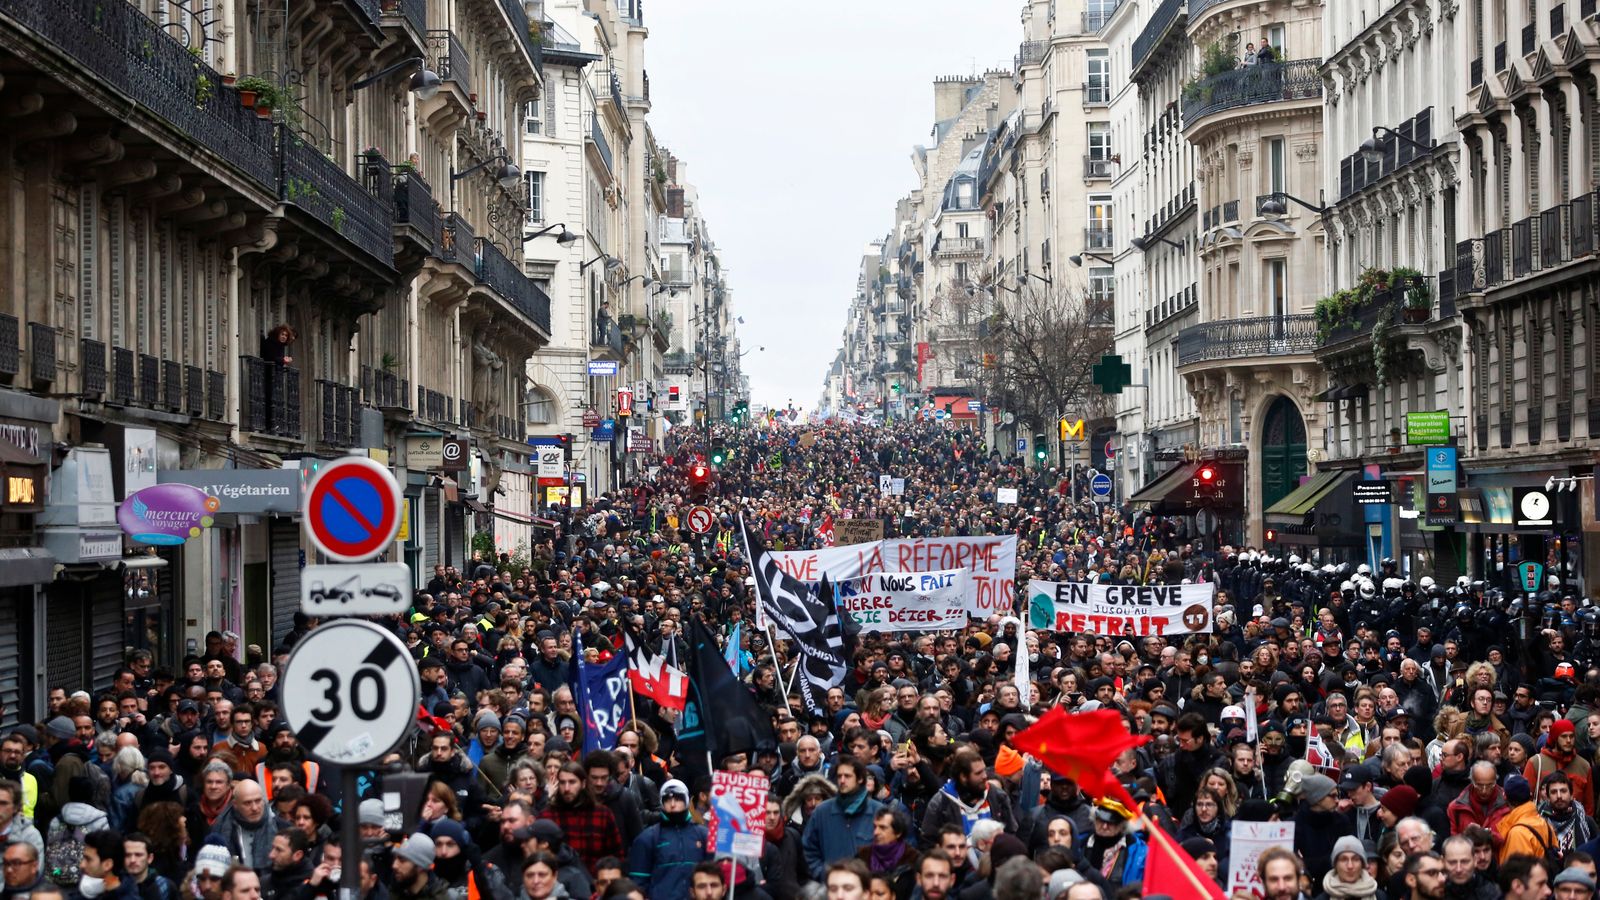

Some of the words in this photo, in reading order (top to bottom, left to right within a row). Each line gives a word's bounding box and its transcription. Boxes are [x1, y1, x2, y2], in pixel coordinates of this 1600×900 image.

[1061, 419, 1084, 441] M
[212, 484, 290, 499] Végétarien
[145, 509, 200, 521] mercure
[152, 519, 190, 530] voyages
[898, 539, 1002, 573] RÉFORME
[880, 576, 916, 592] NOUS
[972, 576, 1014, 610] TOUS
[1055, 583, 1089, 604] EN
[843, 595, 893, 612] UERRE
[1055, 611, 1169, 636] RETRAIT
[310, 668, 387, 722] 30
[711, 783, 769, 807] C'EST
